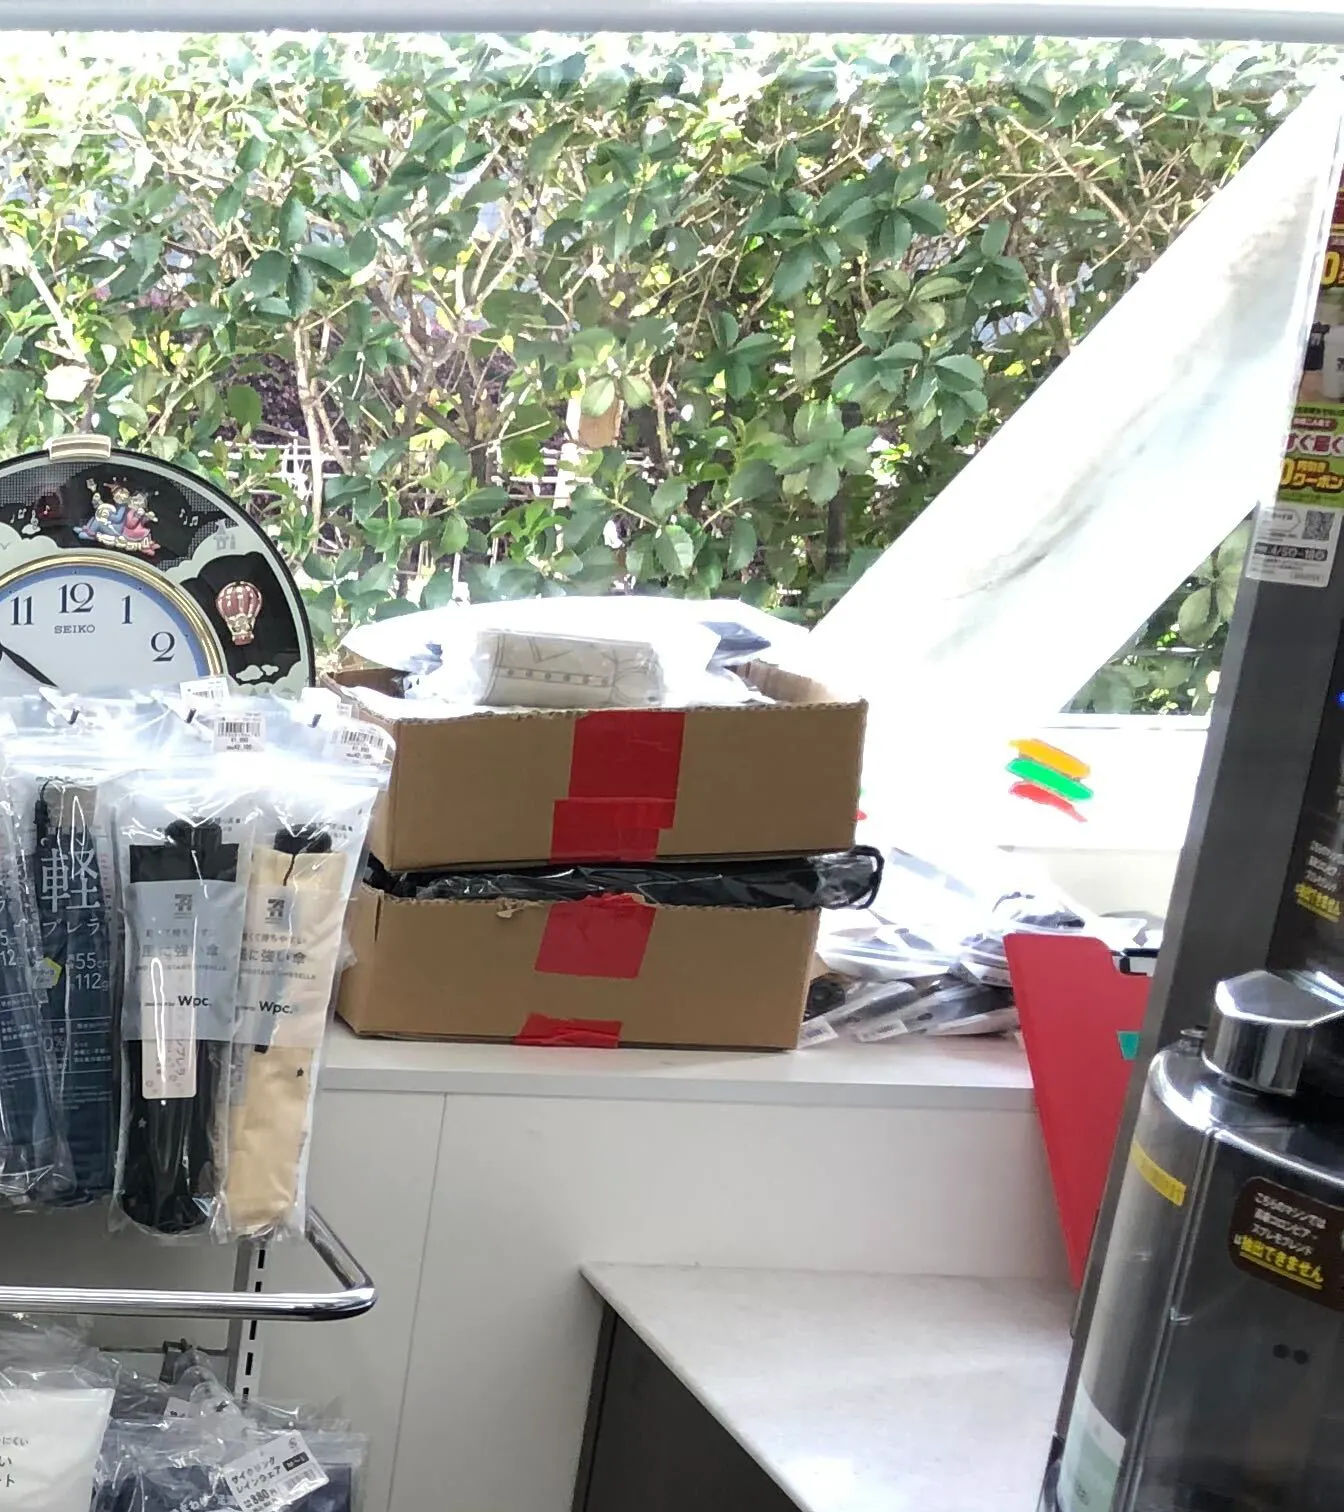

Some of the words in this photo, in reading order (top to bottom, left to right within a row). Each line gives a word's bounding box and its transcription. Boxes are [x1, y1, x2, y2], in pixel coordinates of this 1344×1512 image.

[10, 597, 35, 626] 11
[58, 582, 95, 615] 12
[122, 595, 132, 625] 1
[54, 624, 96, 635] SEIKO
[150, 631, 176, 662] 2
[40, 840, 102, 914] 軽
[178, 995, 211, 1007] Wpc.
[259, 1000, 293, 1015] Wpc.
